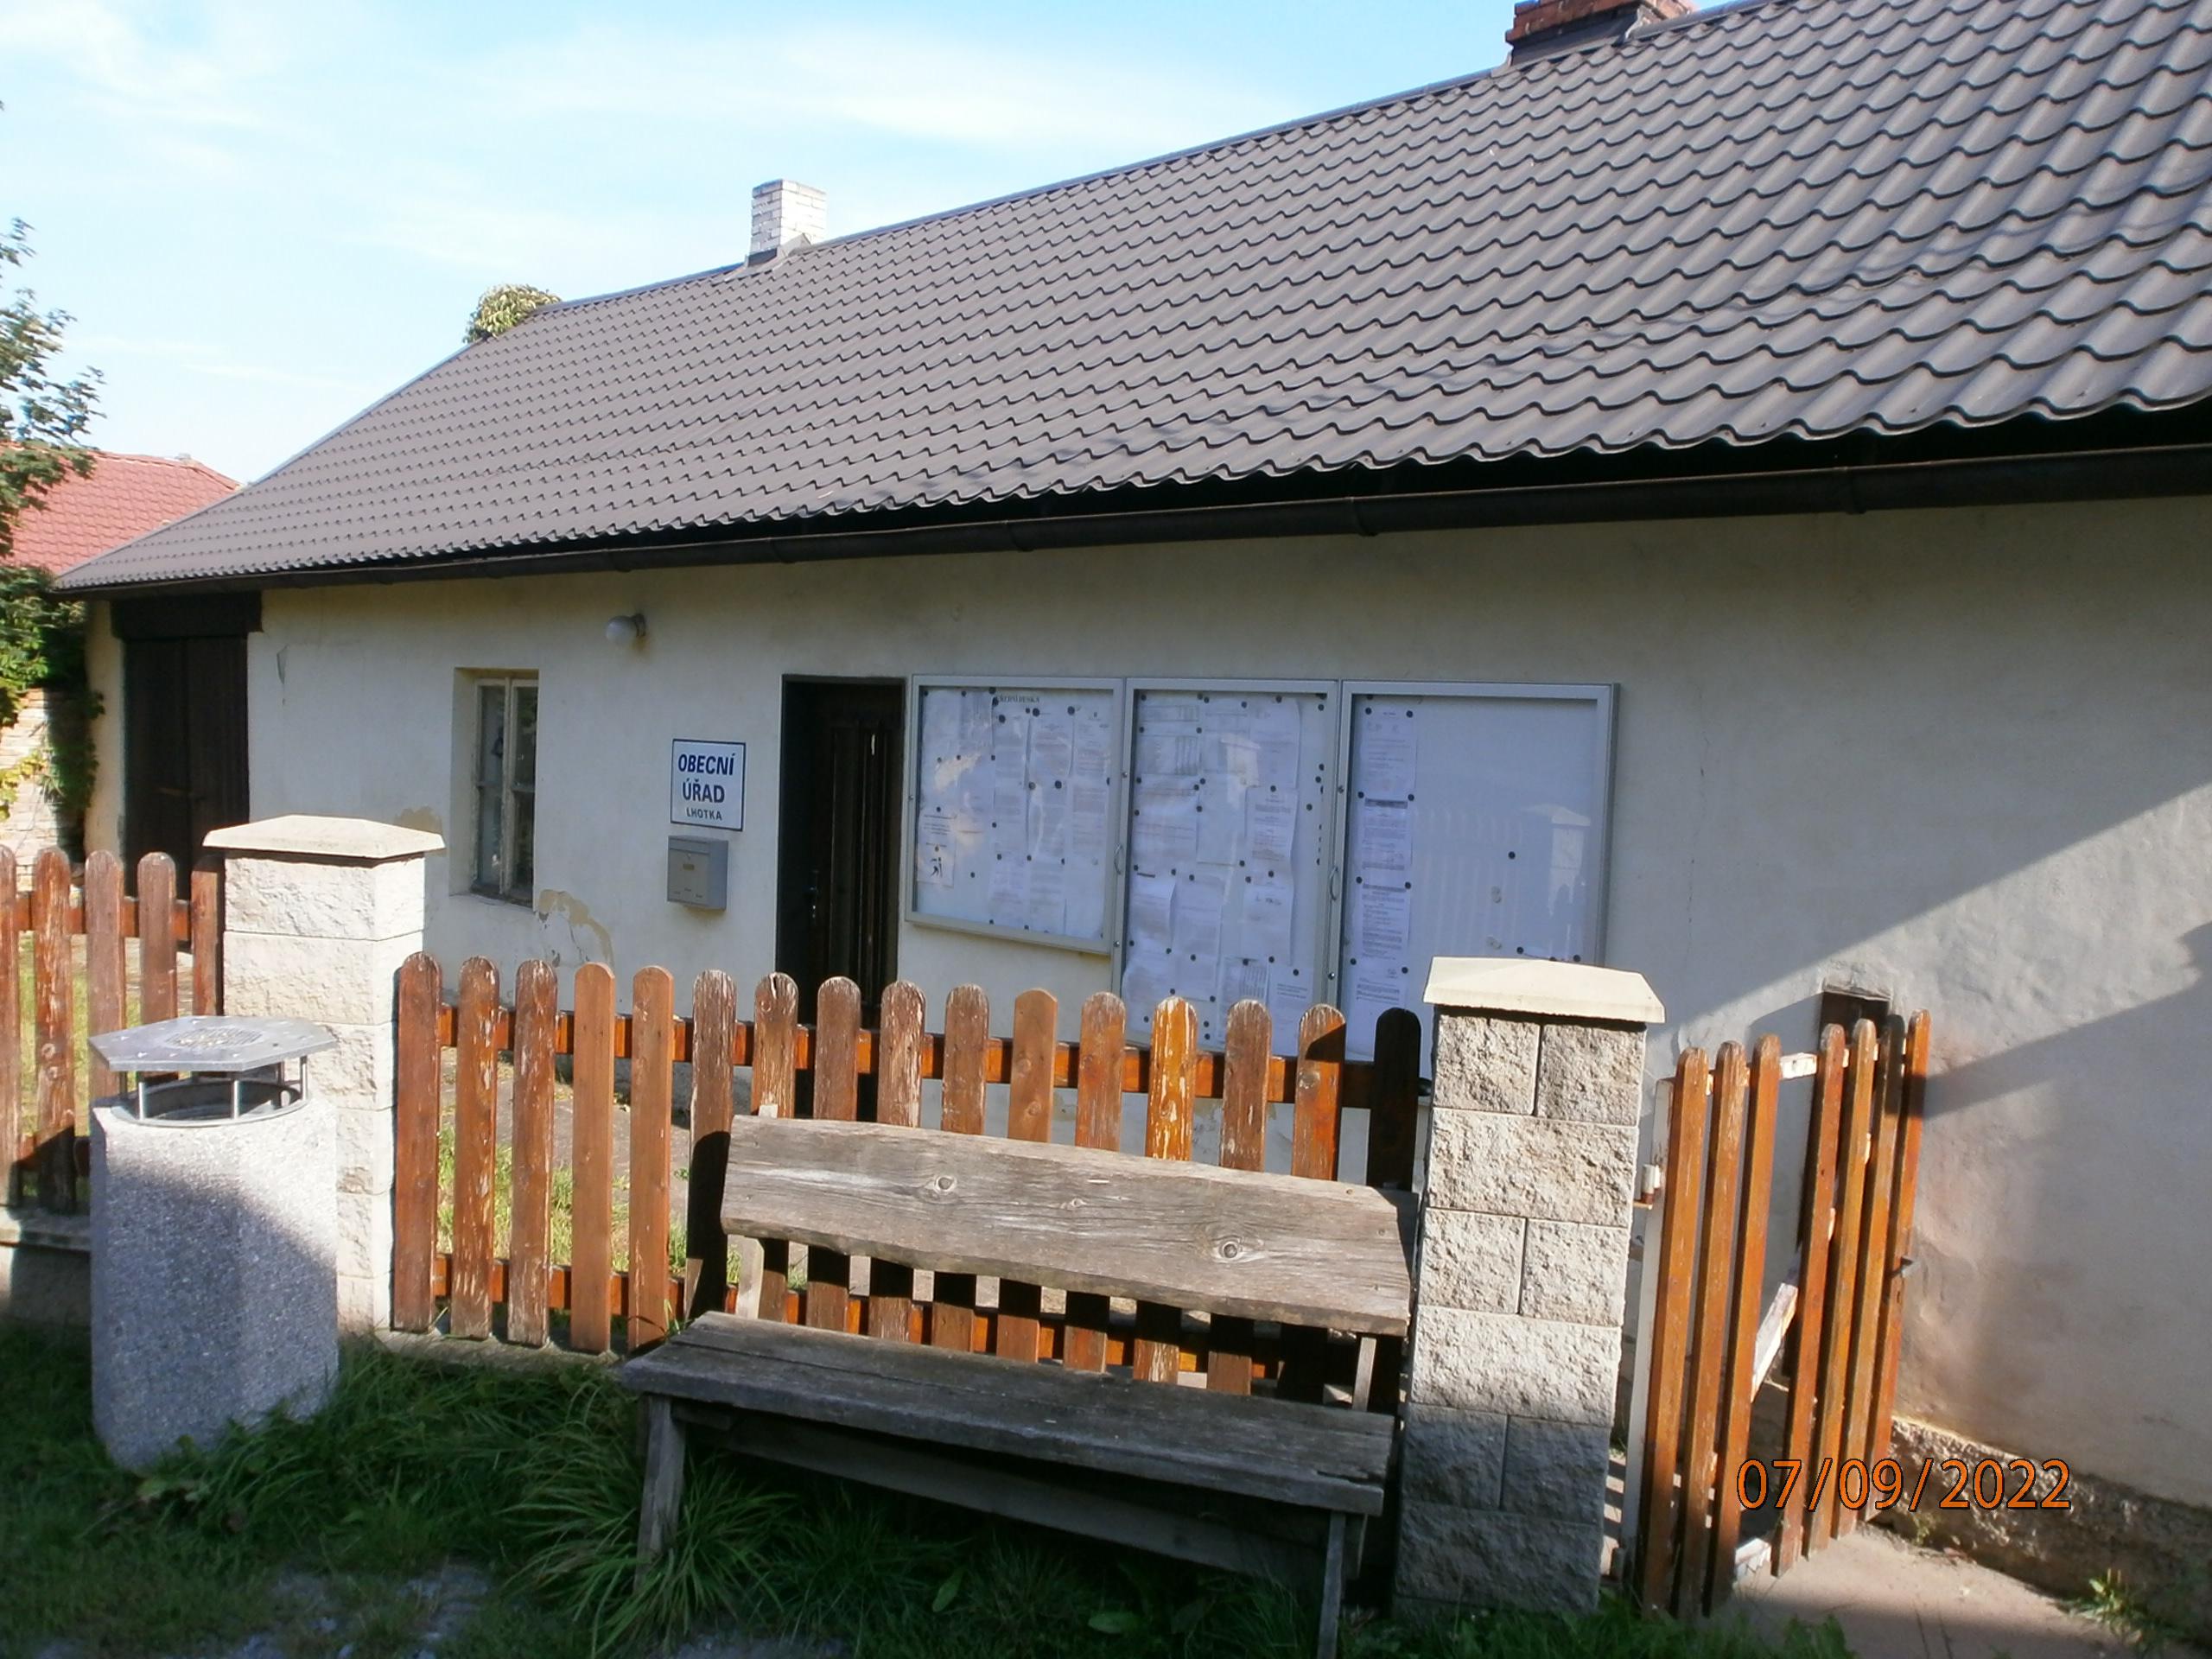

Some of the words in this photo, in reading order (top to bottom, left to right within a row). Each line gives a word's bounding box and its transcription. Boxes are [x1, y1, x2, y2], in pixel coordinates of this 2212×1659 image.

[678, 753, 735, 775] OBECNÍ
[683, 778, 725, 803] ÚŘAD
[686, 807, 722, 821] LHOTKA
